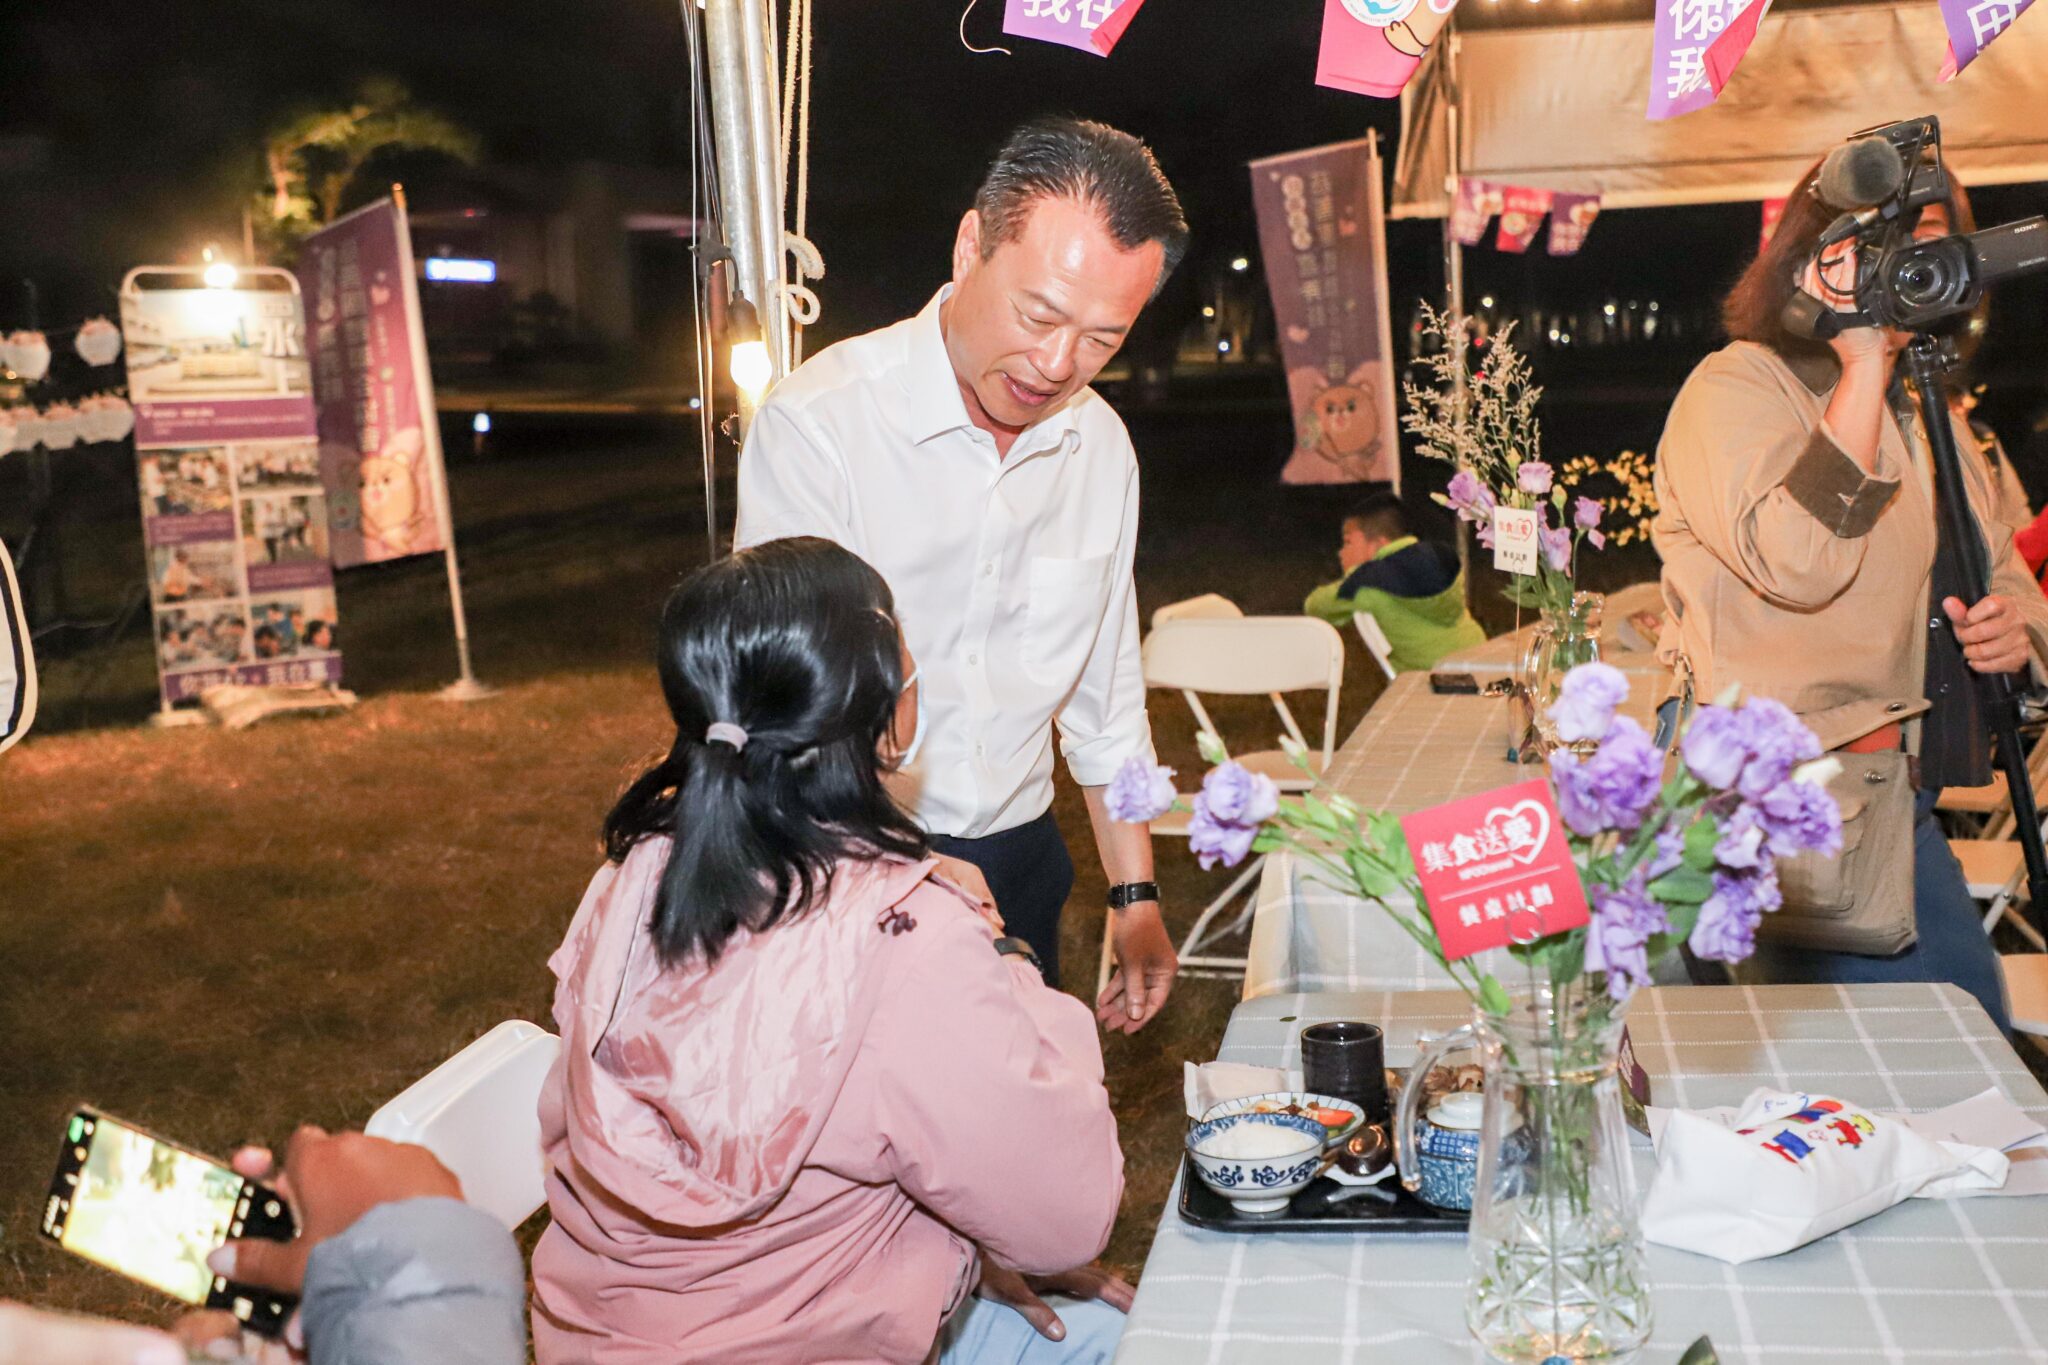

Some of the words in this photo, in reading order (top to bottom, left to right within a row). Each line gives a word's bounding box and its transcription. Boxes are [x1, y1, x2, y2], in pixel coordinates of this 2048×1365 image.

[2014, 223, 2040, 234] SONY
[1421, 815, 1537, 875] 集食送愛
